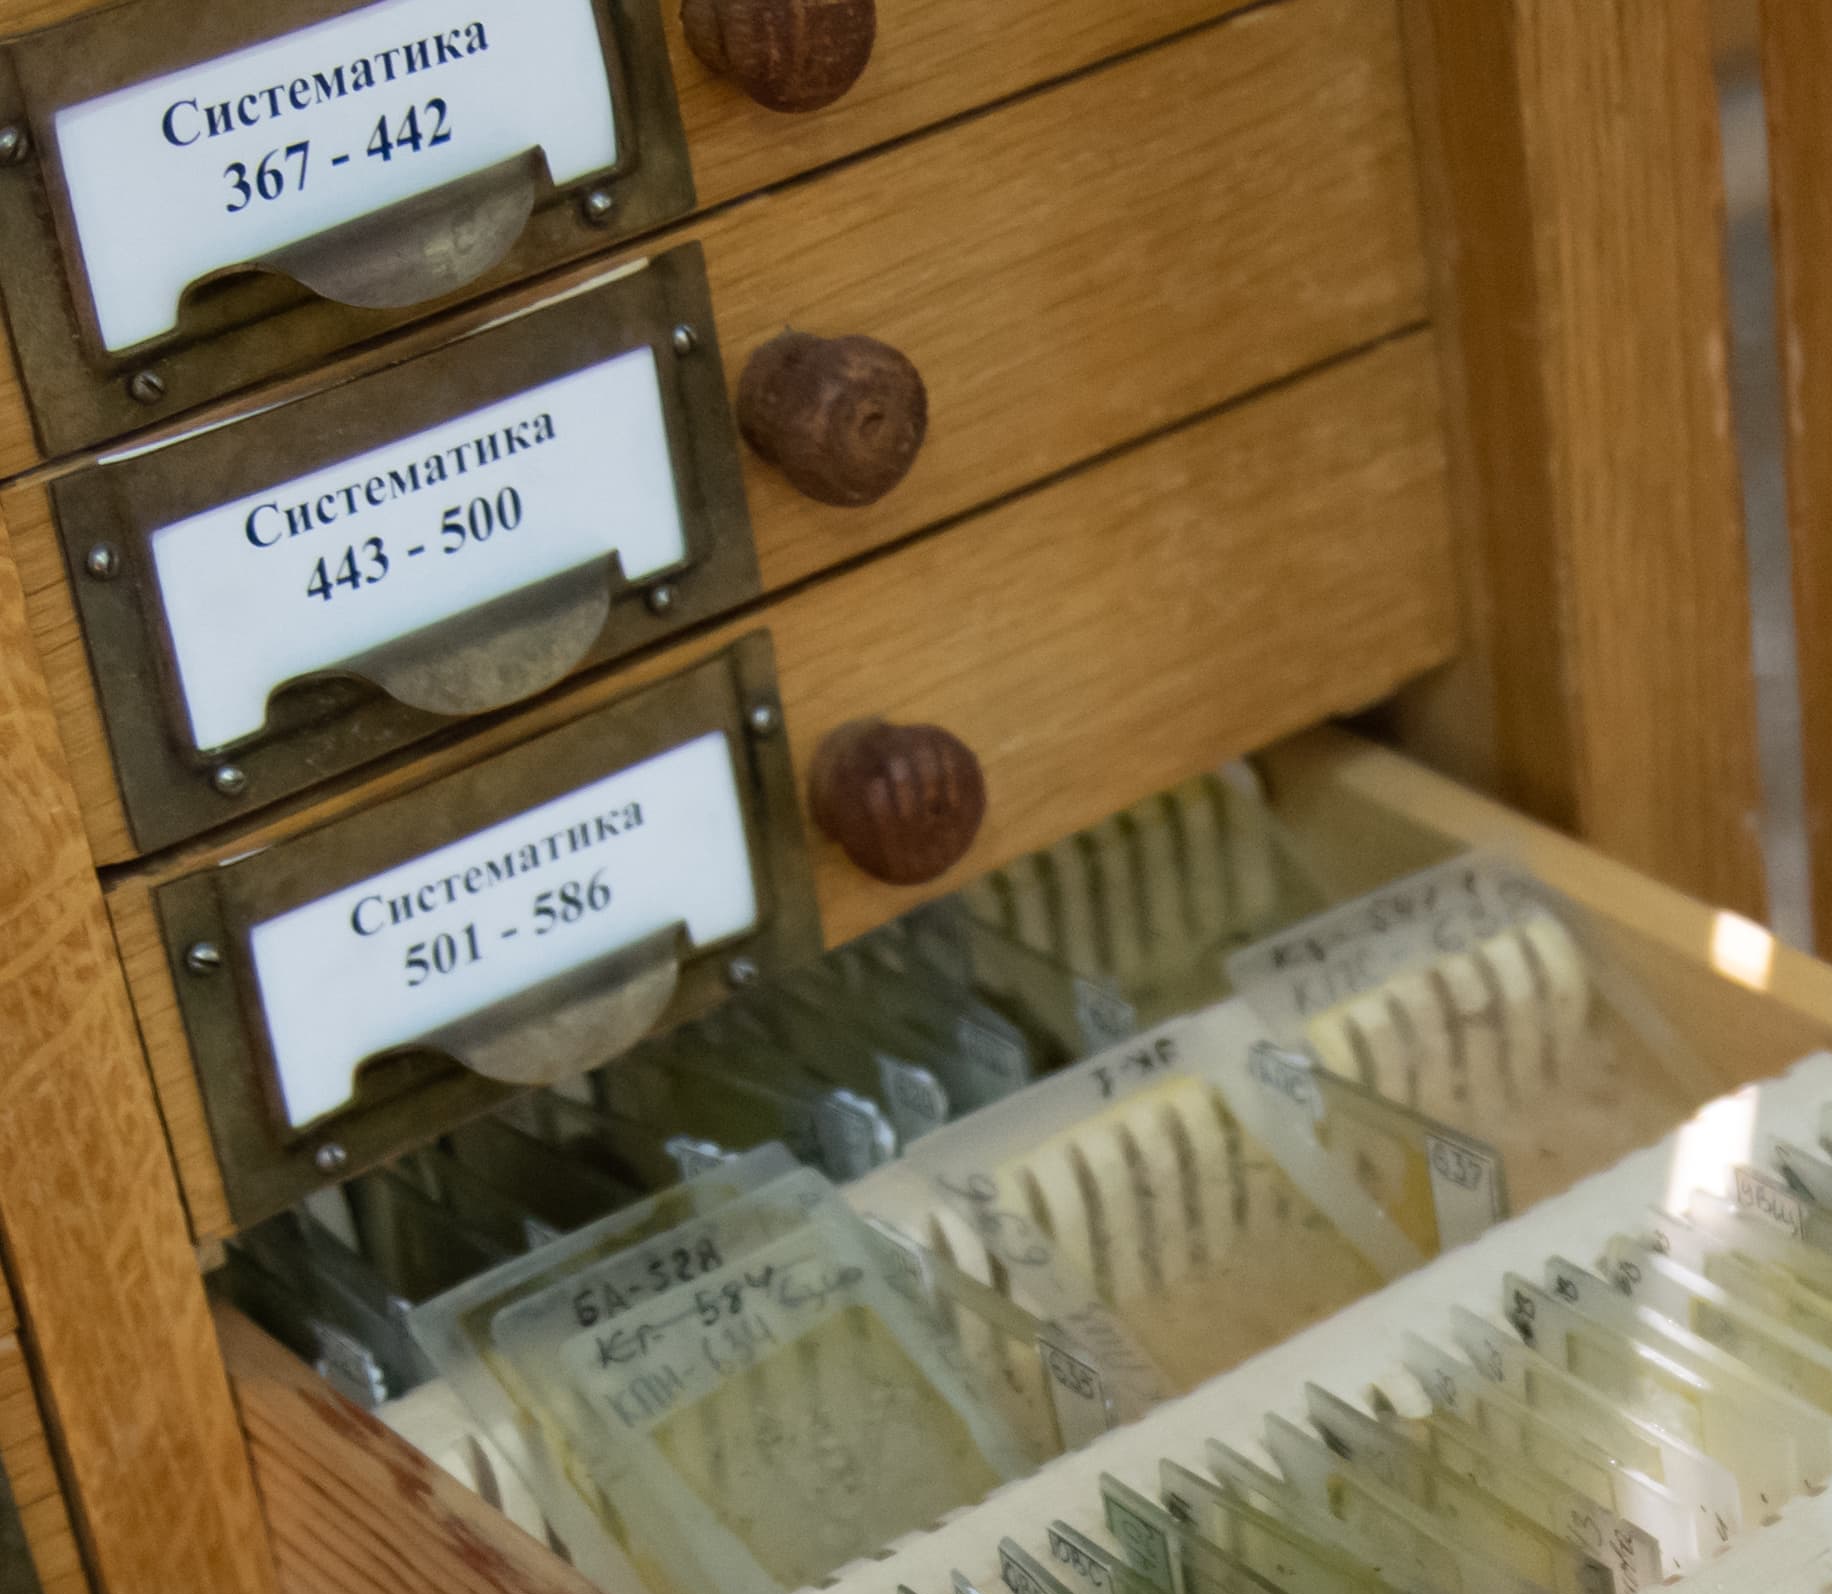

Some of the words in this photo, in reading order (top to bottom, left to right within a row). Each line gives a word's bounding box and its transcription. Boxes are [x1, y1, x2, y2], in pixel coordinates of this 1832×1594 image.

[161, 18, 490, 148] Систематика
[223, 140, 310, 213] 367
[364, 97, 453, 166] 442
[243, 409, 558, 550] Систематика
[305, 535, 391, 602] 443
[441, 486, 524, 555] 500
[350, 800, 645, 938] Систематика
[404, 921, 484, 986] 501
[533, 868, 613, 936] 586
